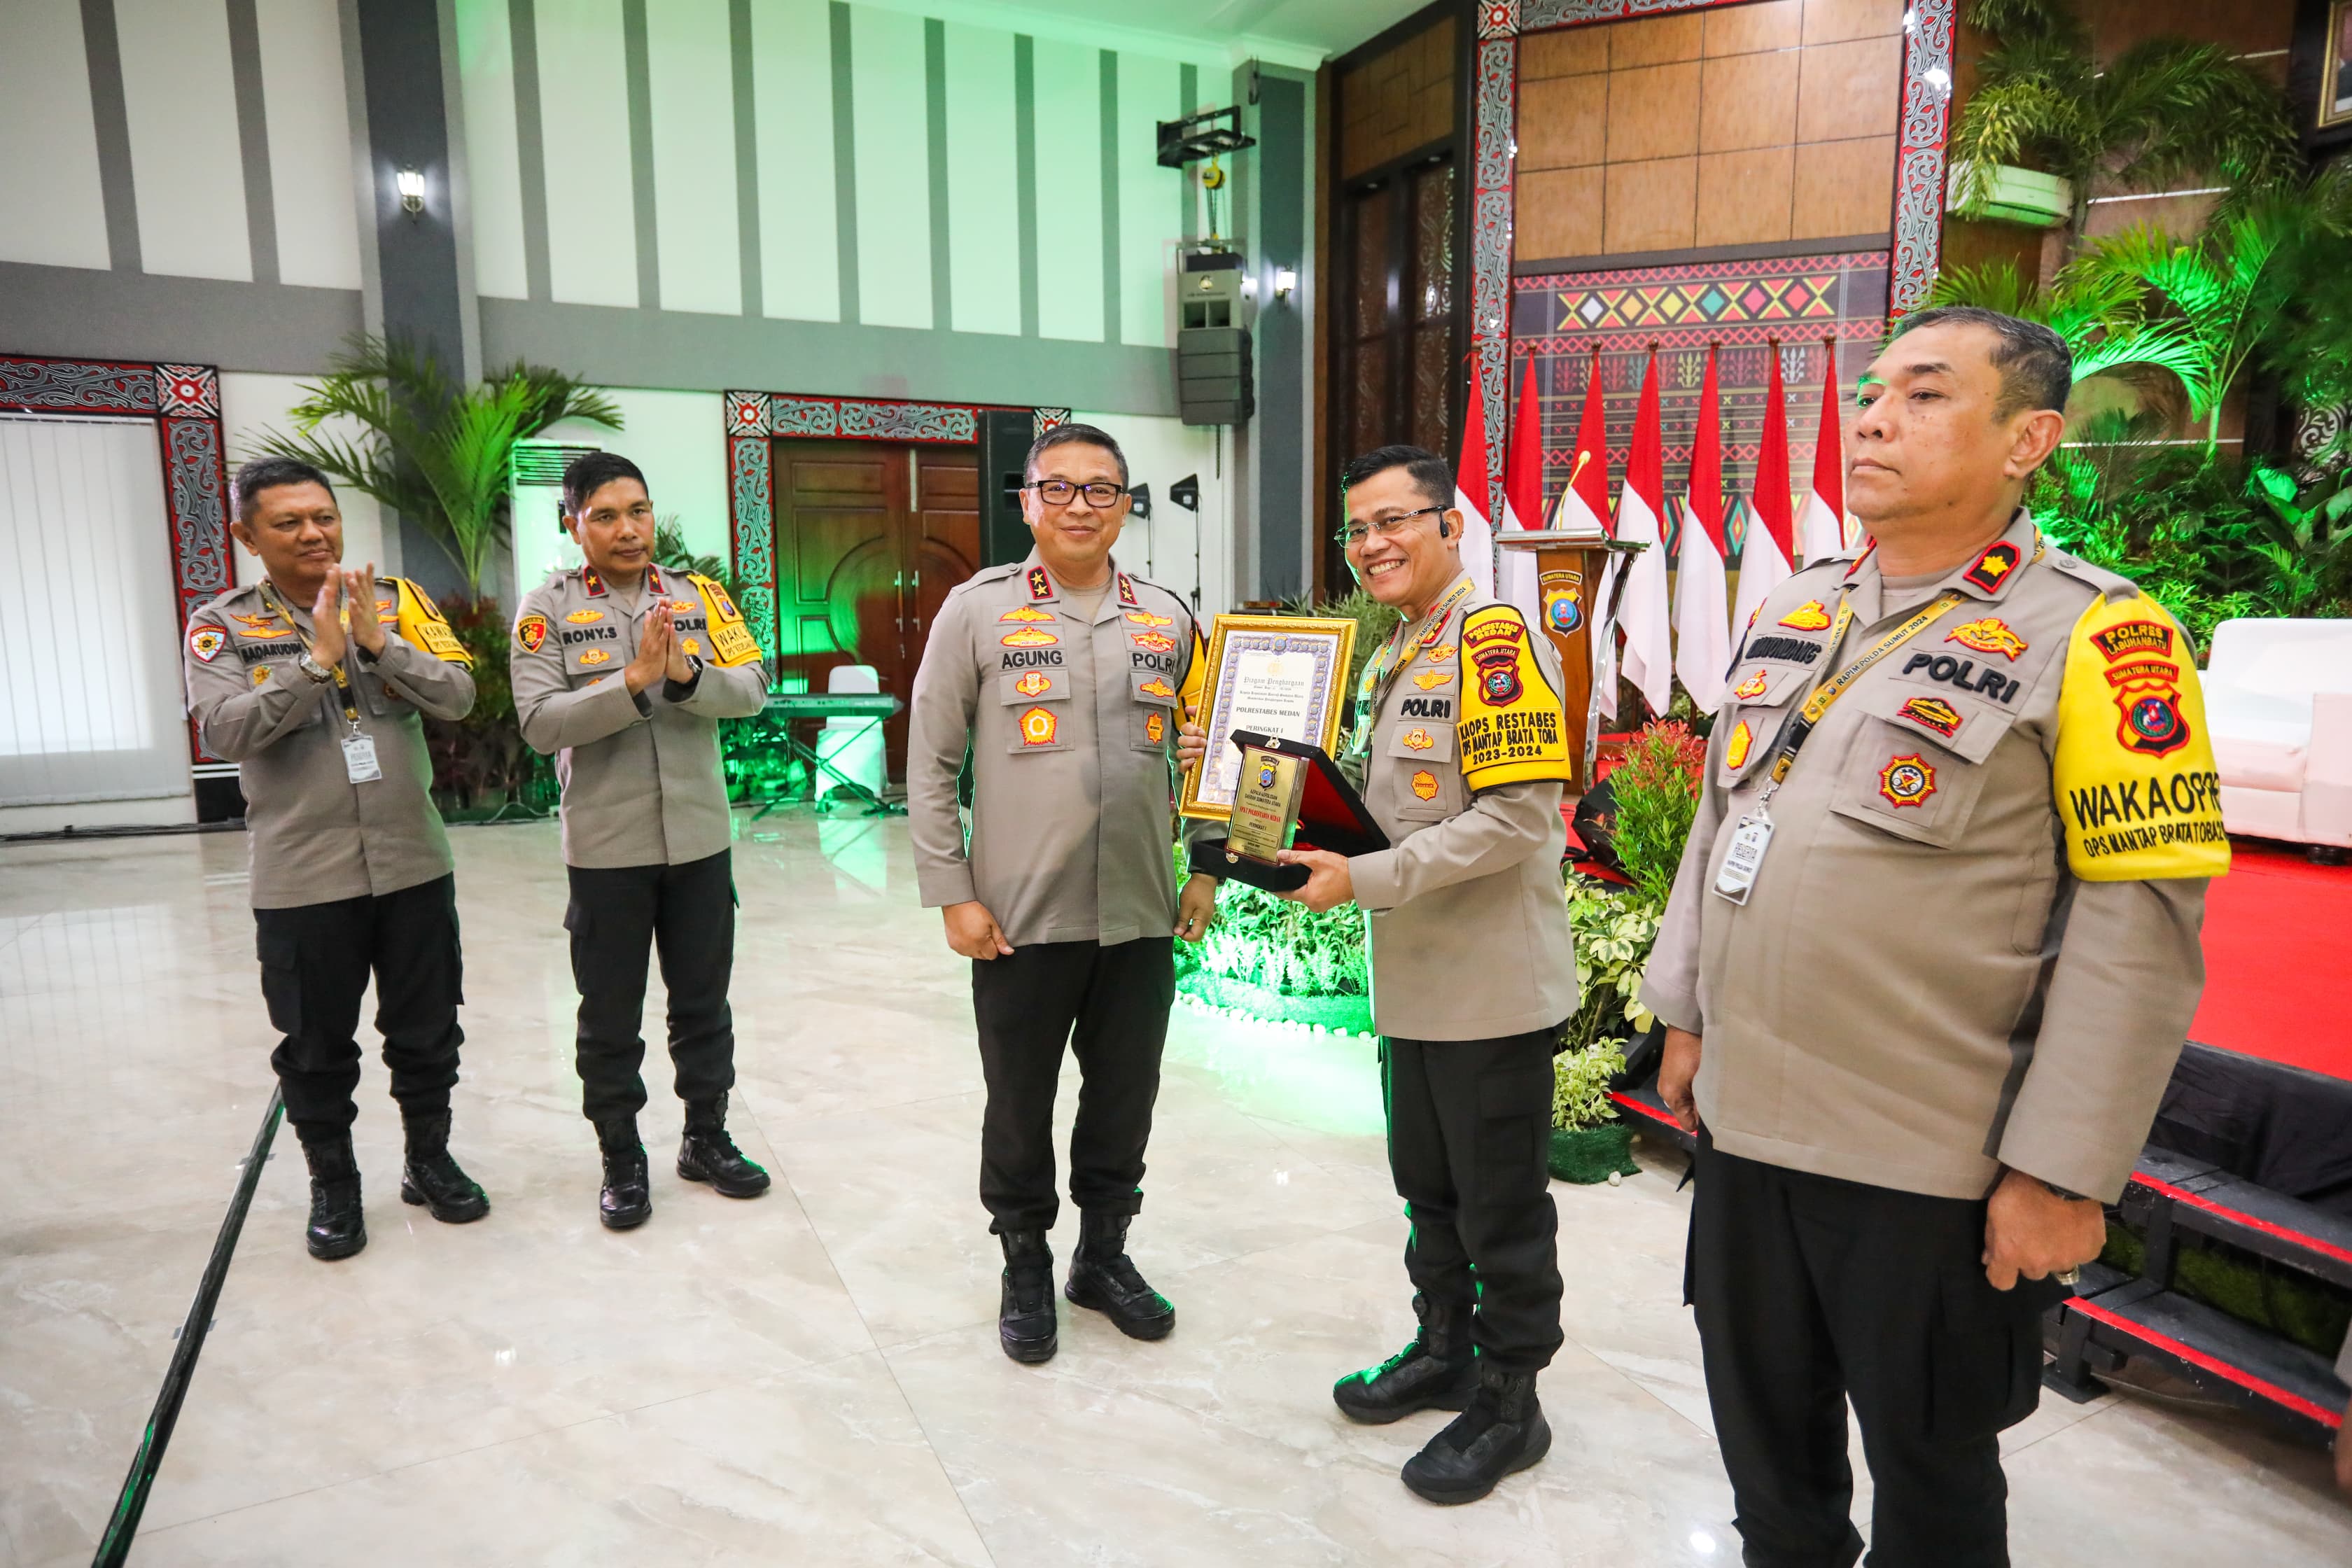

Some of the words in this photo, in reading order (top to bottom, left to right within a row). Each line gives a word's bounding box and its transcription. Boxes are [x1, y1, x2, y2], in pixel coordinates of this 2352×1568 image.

[1564, 573, 1580, 582] UTARA
[1419, 622, 1432, 638] RAPIM
[1431, 607, 1445, 623] POLDA
[1443, 594, 1457, 609] SUMUT
[1455, 587, 1466, 596] 2024
[673, 618, 707, 632] OLRI
[1468, 622, 1520, 639] POLRESTABES
[2105, 624, 2163, 644] POLRES
[562, 626, 617, 645] RONY.S
[1476, 629, 1512, 641] MEDAN
[1476, 648, 1499, 662] SUMATERA
[1500, 648, 1516, 657] UTARA
[1836, 665, 1860, 686] RAPIM
[1858, 648, 1885, 668] POLDA
[1883, 629, 1909, 649] SUMUT
[1907, 615, 1928, 630] 2024
[2107, 636, 2167, 655] LABUHANBATU
[1002, 650, 1063, 669] AGUNG
[1132, 652, 1175, 675] POLRI
[1902, 652, 2020, 704] POLRI
[2111, 665, 2150, 680] SUMATERA
[2150, 665, 2173, 677] UTARA
[1236, 706, 1278, 715] POLRESTABES
[1400, 698, 1451, 718] POLRI
[1245, 724, 1279, 734] PERINGKAT
[1459, 717, 1489, 741] KAOPS
[1496, 712, 1557, 729] RESTABES
[1472, 731, 1503, 752] MANTAP
[1506, 727, 1534, 746] BRATA
[1539, 727, 1558, 745] TOBA
[1473, 745, 1543, 765] 2023-2024
[2083, 835, 2110, 858] OPS
[2108, 826, 2157, 853] MANTAP
[2158, 821, 2193, 844] BRATA
